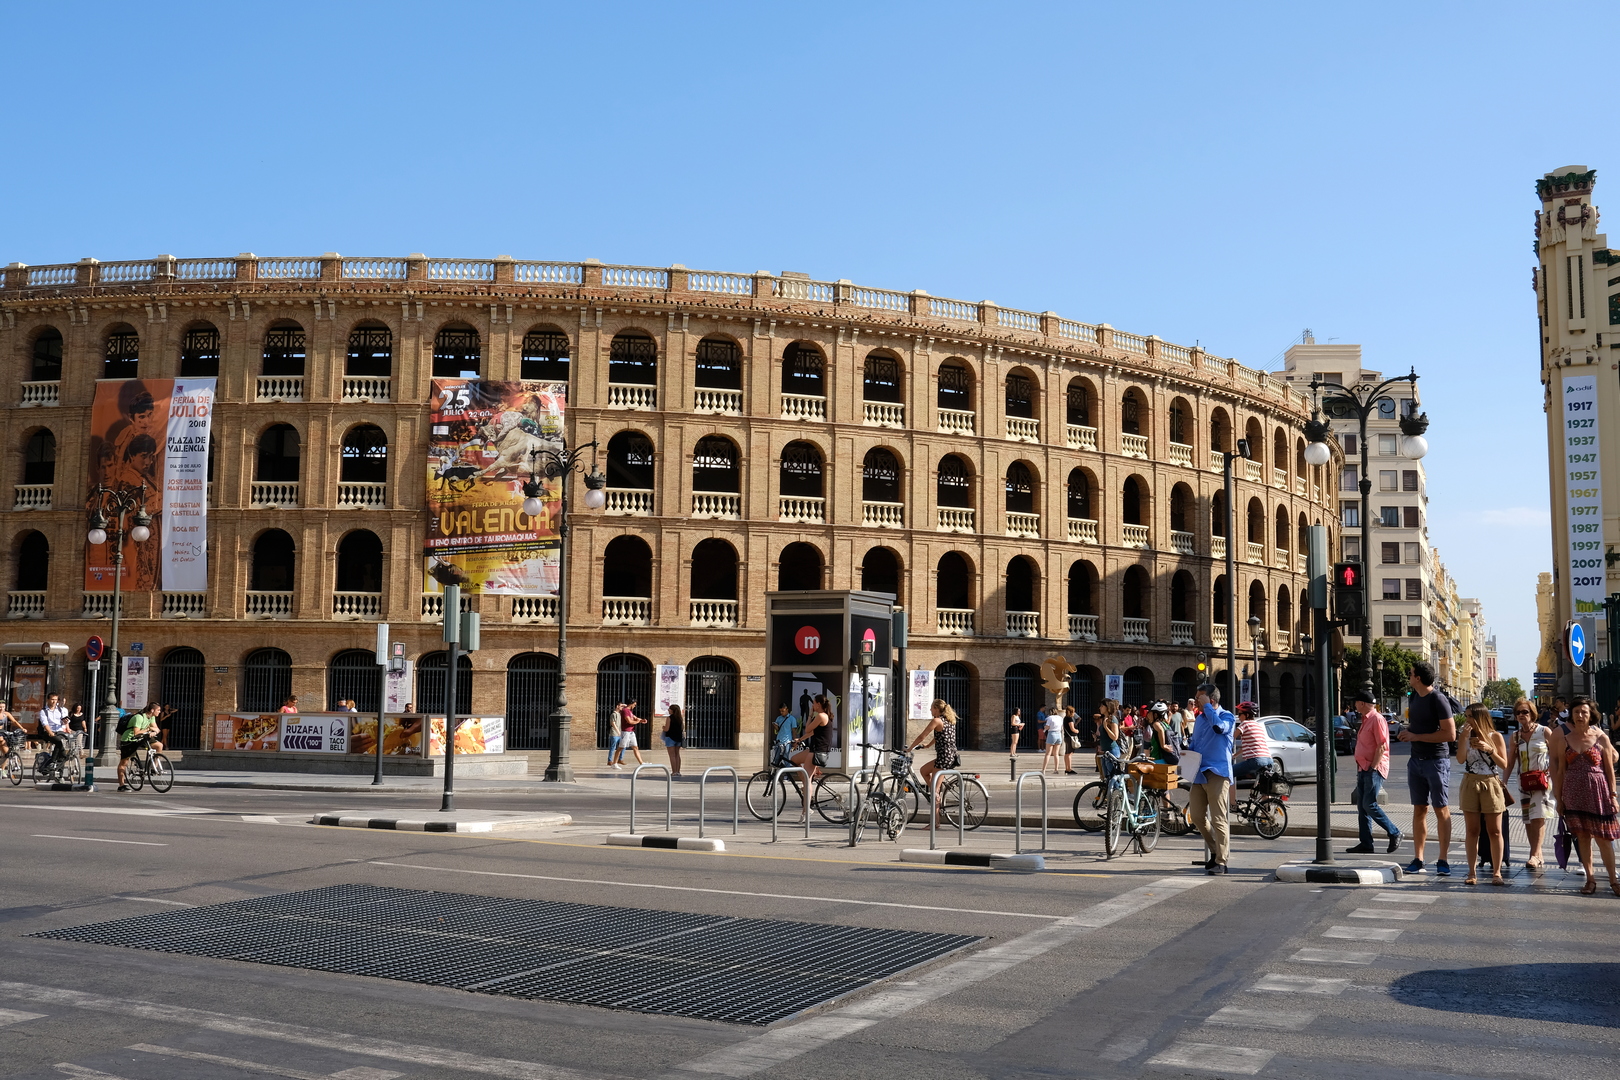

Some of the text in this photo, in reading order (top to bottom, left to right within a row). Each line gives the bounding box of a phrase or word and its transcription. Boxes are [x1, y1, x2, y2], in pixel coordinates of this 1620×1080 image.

[439, 390, 470, 410] 25
[1568, 402, 1592, 411] 1917
[170, 406, 208, 418] JULIO
[1568, 419, 1594, 428] 1927
[1568, 436, 1595, 446] 1937
[1568, 454, 1596, 463] 1947
[1570, 471, 1597, 480] 1957
[1570, 489, 1598, 498] 1967
[1571, 506, 1598, 515] 1977
[440, 506, 550, 536] VALENCIA
[1572, 524, 1599, 533] 1987
[484, 533, 537, 542] TAUROMAQUIAS
[1572, 541, 1600, 550] 1997
[1572, 559, 1602, 568] 2007
[1574, 577, 1602, 586] 2017
[286, 725, 318, 734] RUZAFA
